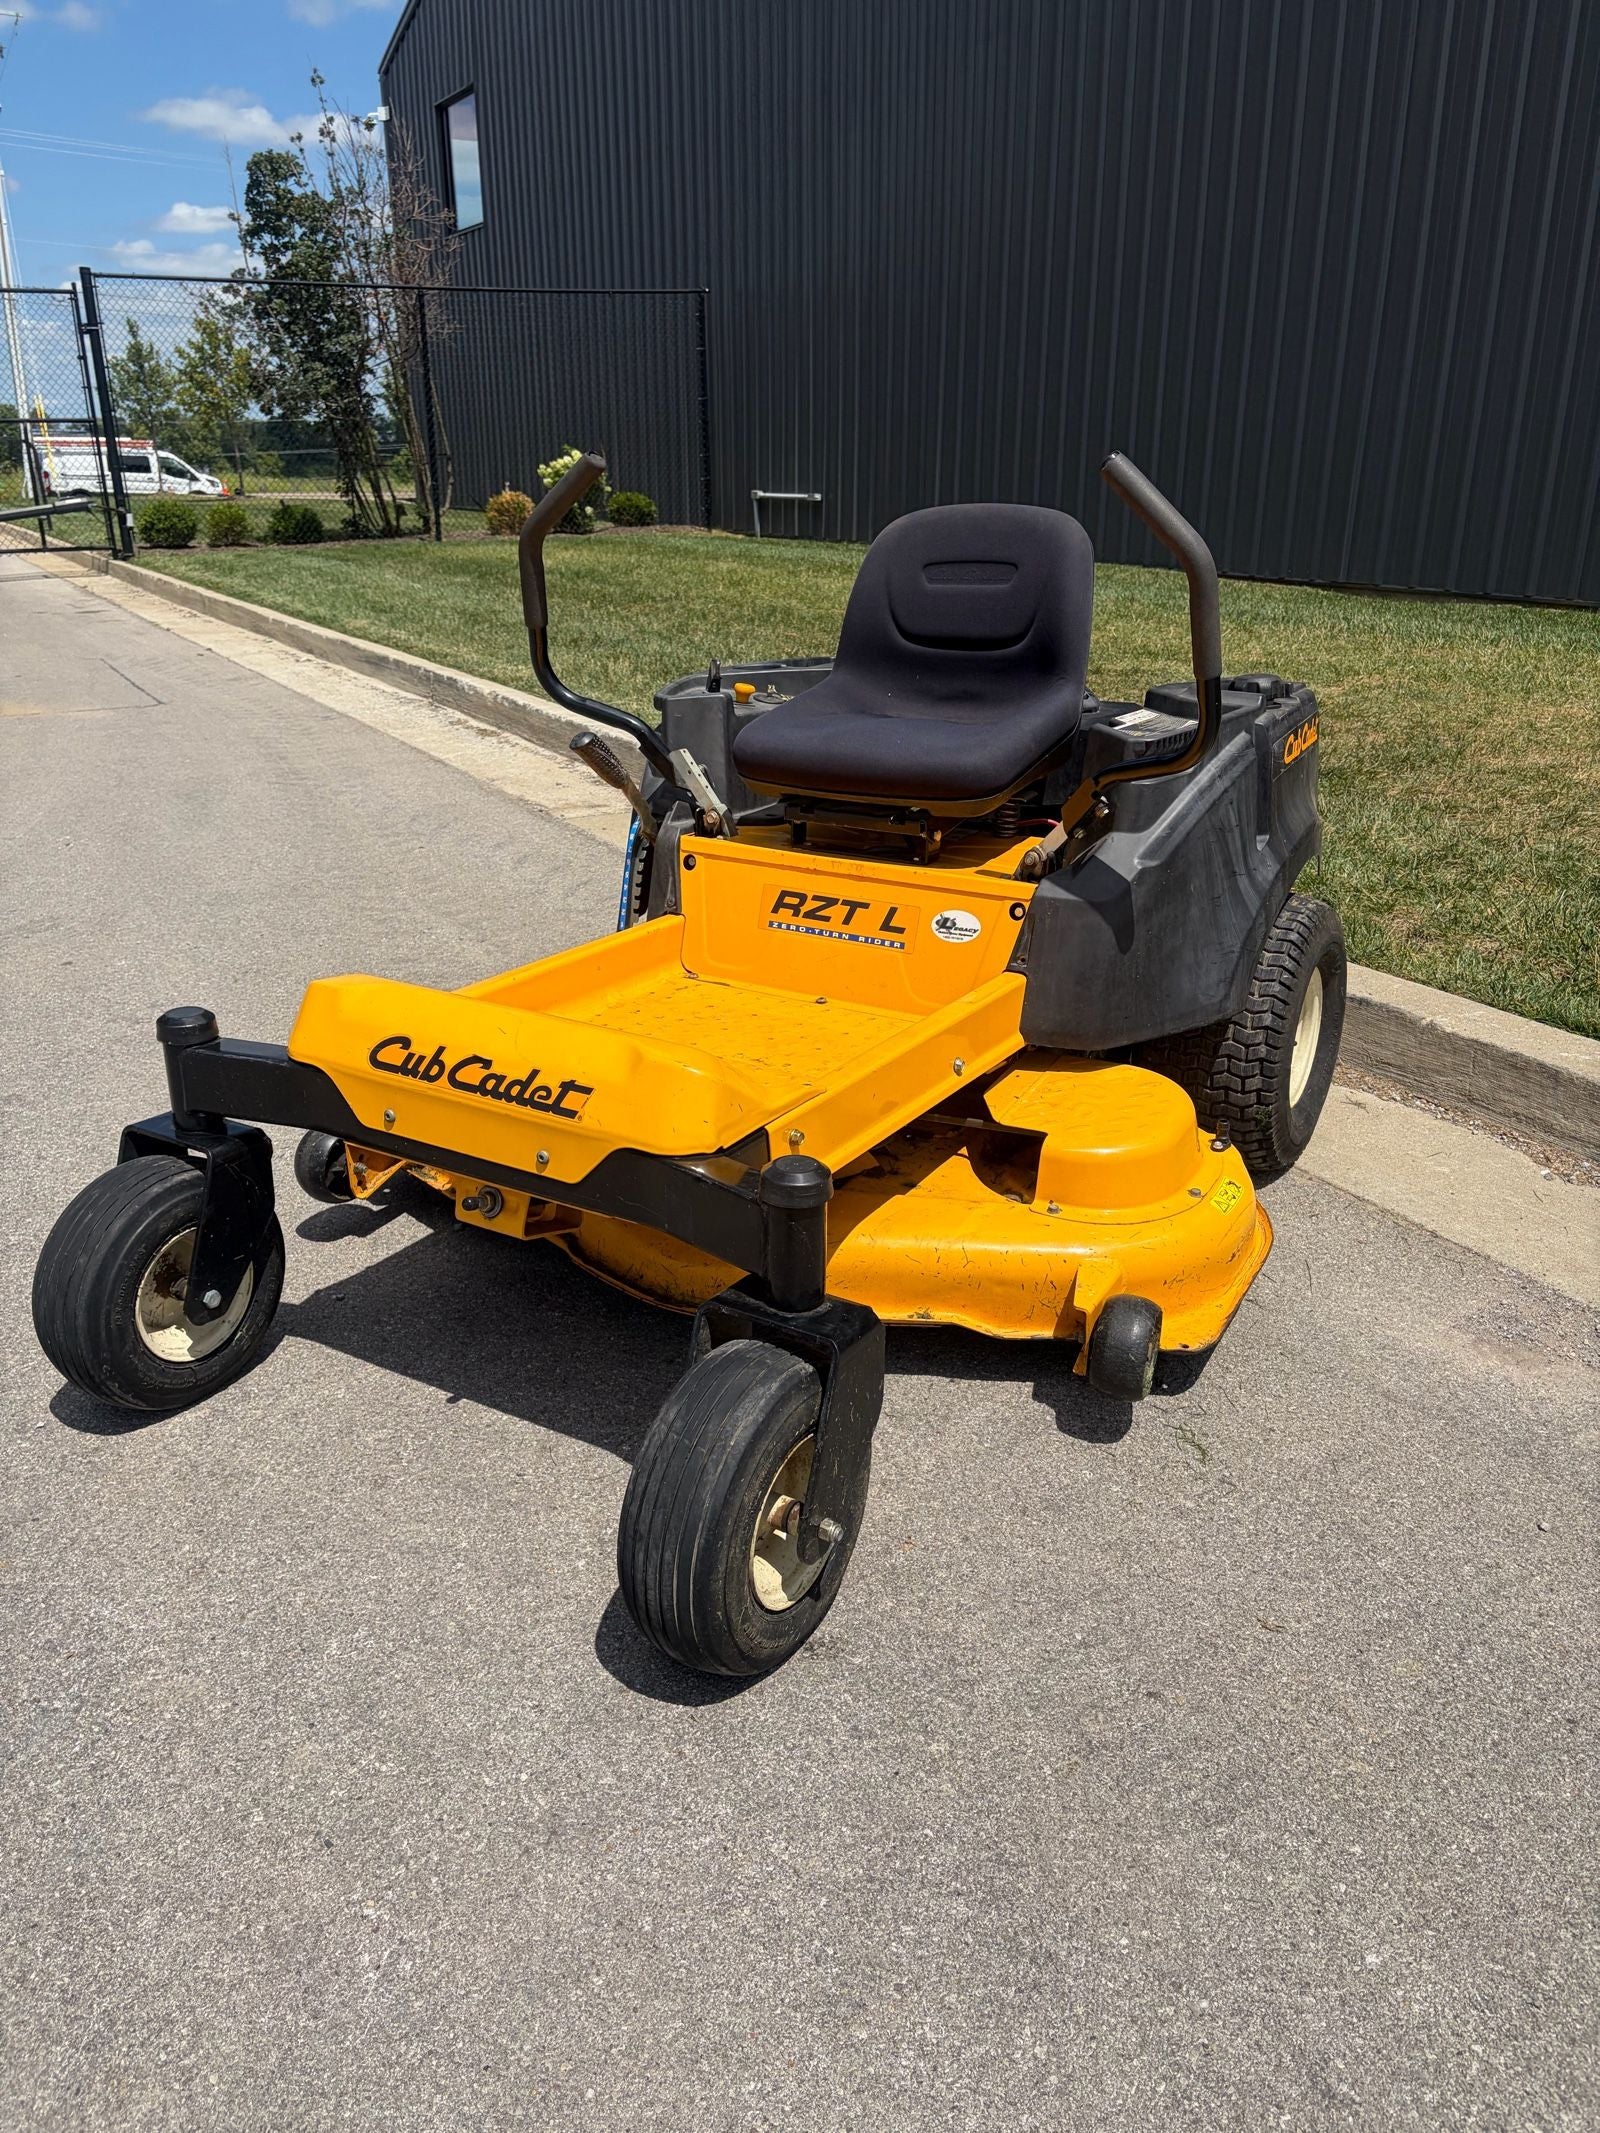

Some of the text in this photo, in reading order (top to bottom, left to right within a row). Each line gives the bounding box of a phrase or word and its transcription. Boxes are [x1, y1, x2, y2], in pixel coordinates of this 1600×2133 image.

[1284, 729, 1302, 765] Cub
[770, 889, 906, 935] RZT L
[858, 936, 901, 949] RIDER
[369, 1035, 594, 1120] Cub Cadet
